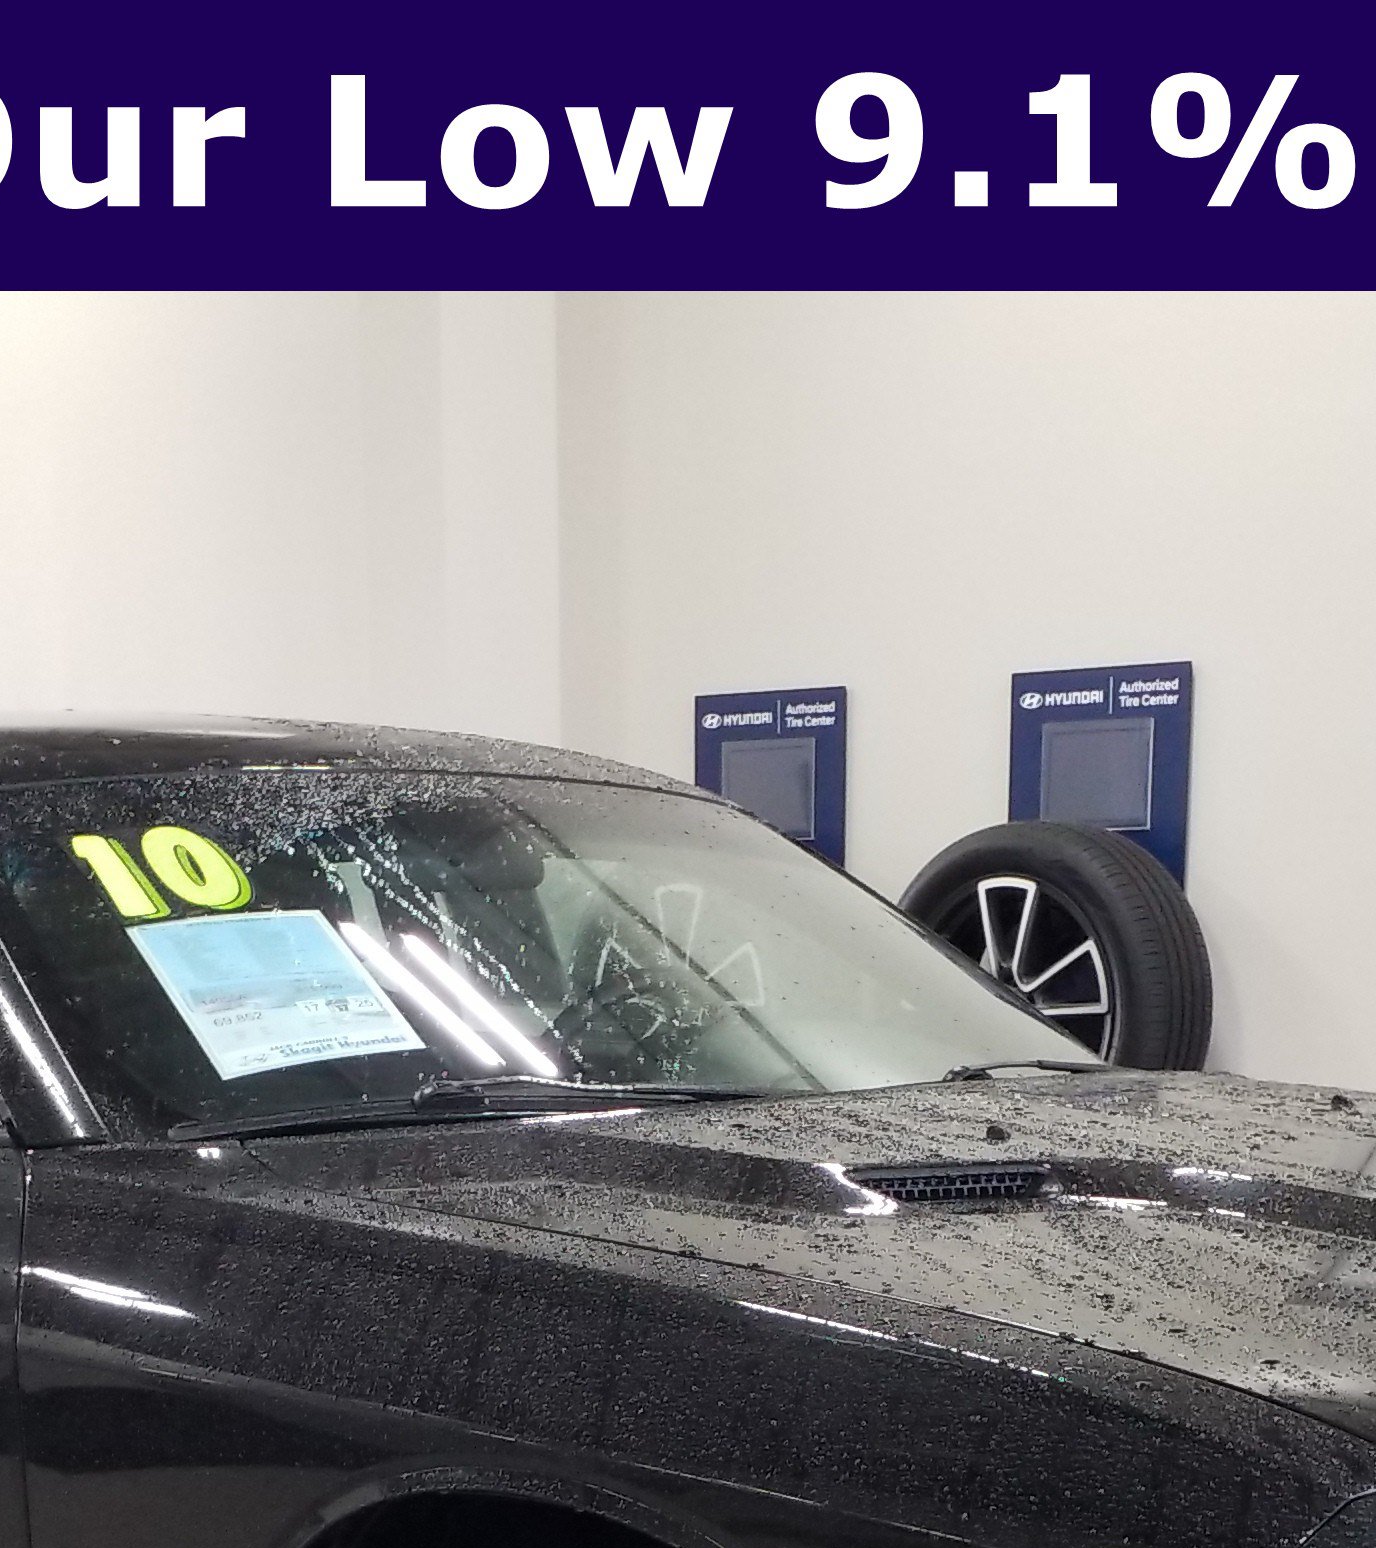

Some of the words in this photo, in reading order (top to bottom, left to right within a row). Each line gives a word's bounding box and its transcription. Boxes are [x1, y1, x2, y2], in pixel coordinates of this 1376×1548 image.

[1118, 677, 1179, 693] Authorized
[1043, 690, 1104, 707] HYUNDAI
[1118, 694, 1140, 708] Tire
[1141, 693, 1179, 707] Center
[784, 700, 837, 716] Authorized
[723, 711, 773, 727] HYUNDAI
[784, 716, 804, 729] Tire
[805, 715, 836, 728] Center
[71, 825, 253, 918] 10
[337, 1035, 408, 1052] Hyundai
